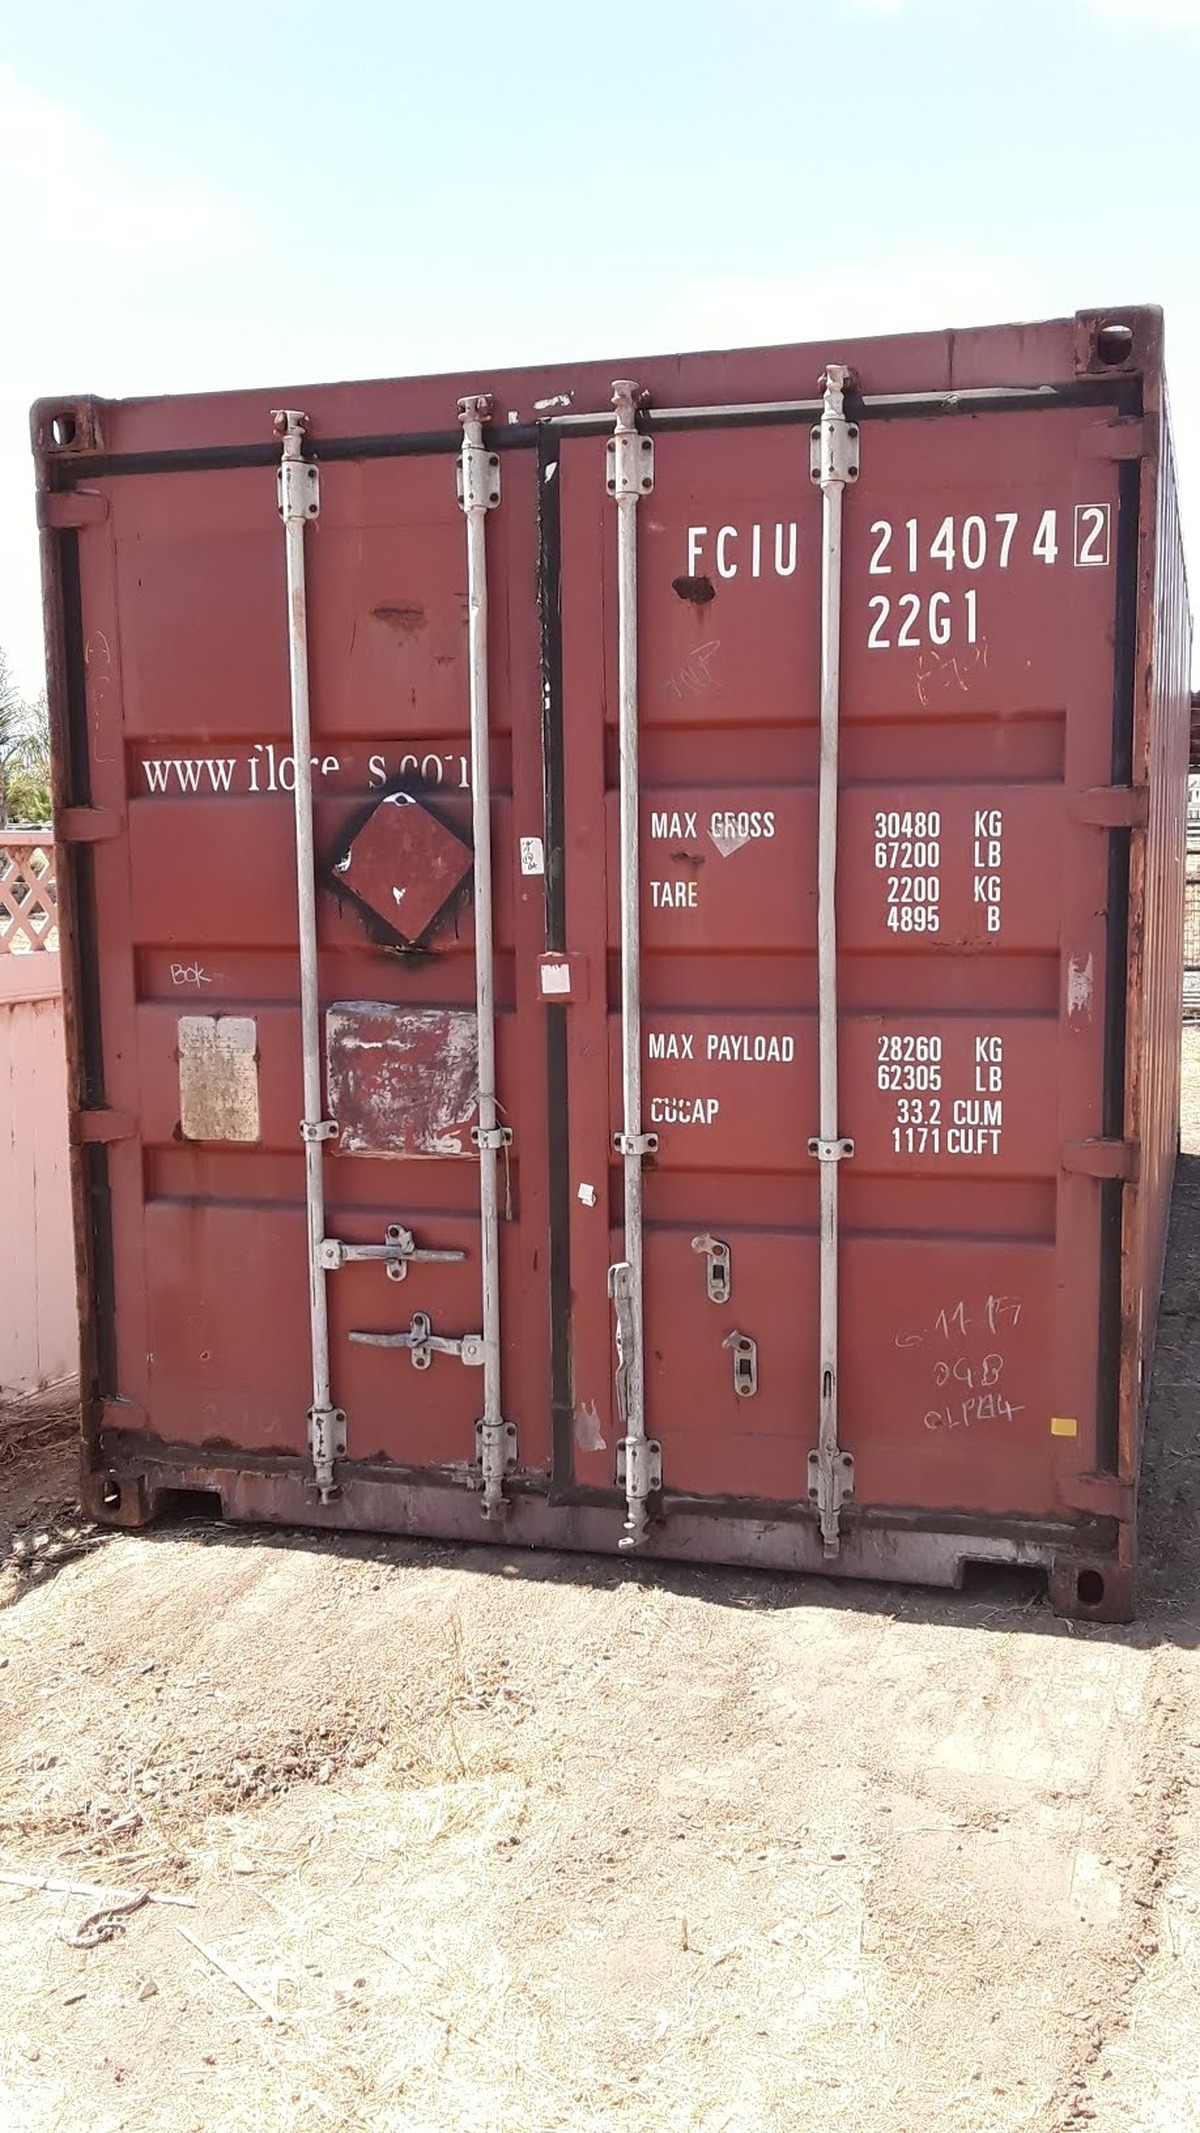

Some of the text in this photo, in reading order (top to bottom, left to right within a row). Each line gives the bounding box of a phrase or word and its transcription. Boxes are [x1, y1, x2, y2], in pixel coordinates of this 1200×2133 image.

[687, 522, 798, 578] FCIU
[868, 509, 1060, 575] 214074
[867, 589, 978, 649] 22G1
[651, 810, 1002, 839] MAX GROSS 30480 KG
[874, 840, 1001, 869] 67200 LB
[650, 875, 1001, 908] TARE 2200 KG
[887, 905, 940, 933] 4895
[649, 1033, 1002, 1062] MAX PAYLOAD 28260 KG
[878, 1064, 1002, 1092] 62305 LB
[897, 1098, 941, 1125] 33.2
[953, 1099, 1002, 1126] CU.M
[892, 1127, 1002, 1154] 1171 CU.FT
